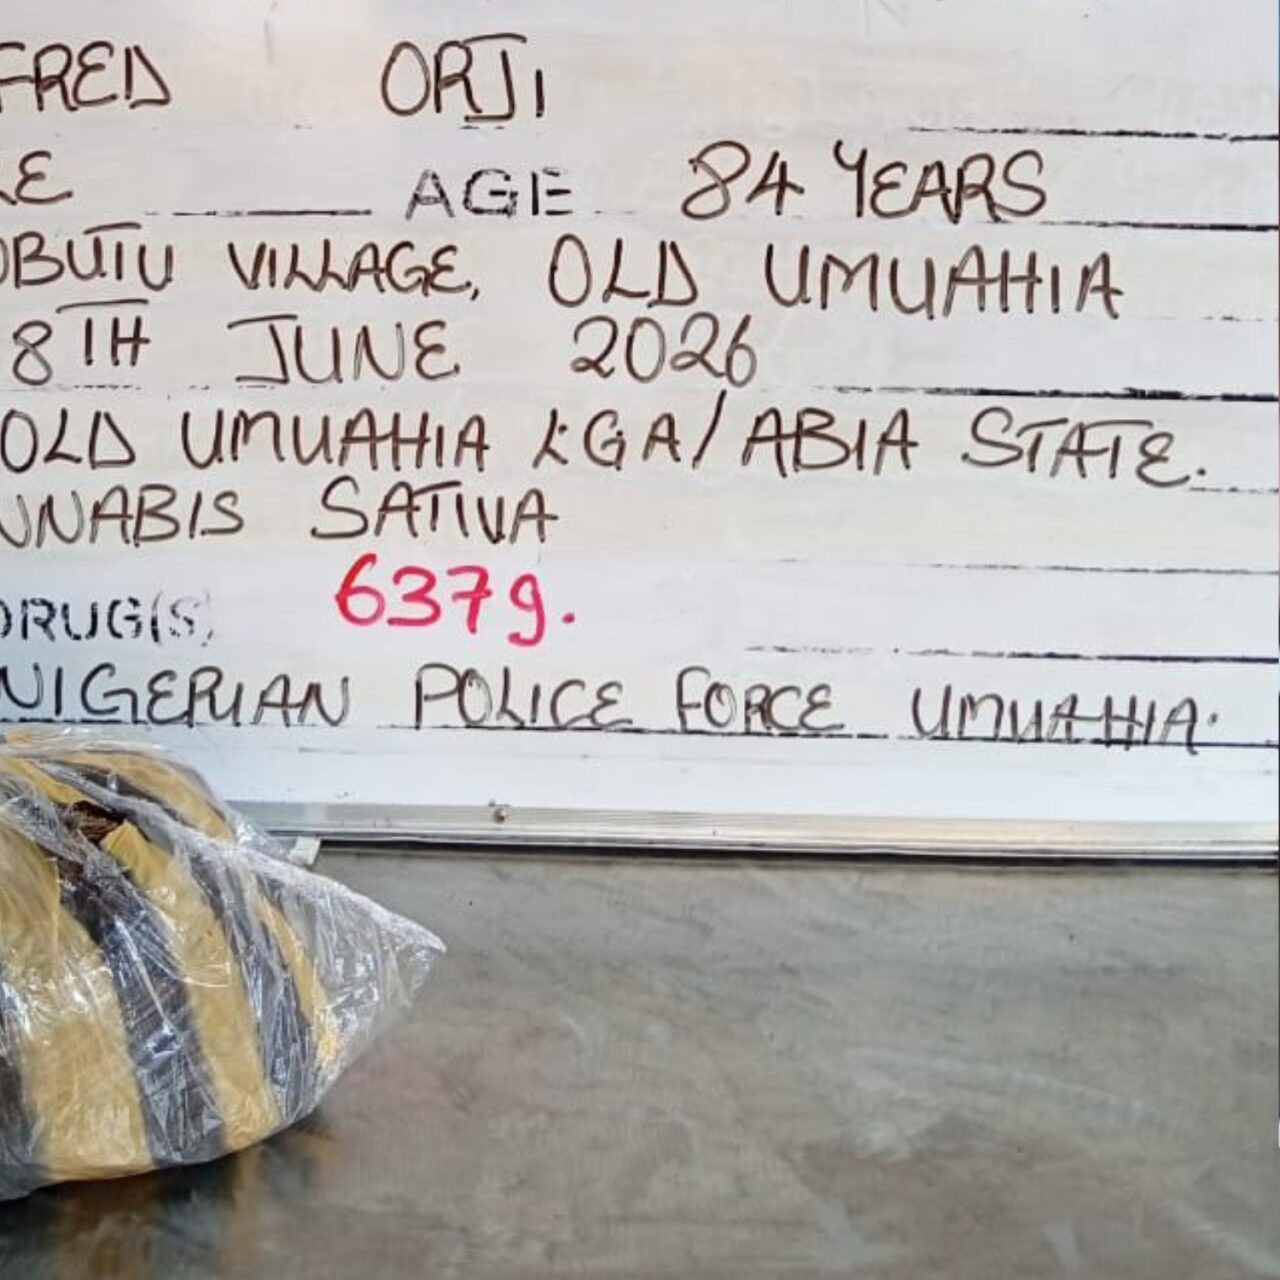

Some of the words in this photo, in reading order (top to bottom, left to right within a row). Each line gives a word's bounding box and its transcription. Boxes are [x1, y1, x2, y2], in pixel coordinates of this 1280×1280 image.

[381, 33, 545, 122] ORJI
[405, 168, 572, 218] AGE
[681, 139, 804, 220] 84
[833, 139, 1048, 223] YEARS
[227, 238, 480, 301] VILLAGE,
[548, 233, 699, 308] OLD
[764, 242, 1124, 319] UMUAHIA
[227, 313, 460, 385] JUNE
[570, 312, 757, 387] 2026
[0, 407, 137, 473] OLD
[180, 408, 489, 471] UMUAHIA
[310, 475, 558, 543] SATIVA
[414, 662, 633, 731] POLICE
[675, 666, 843, 733] FORCE
